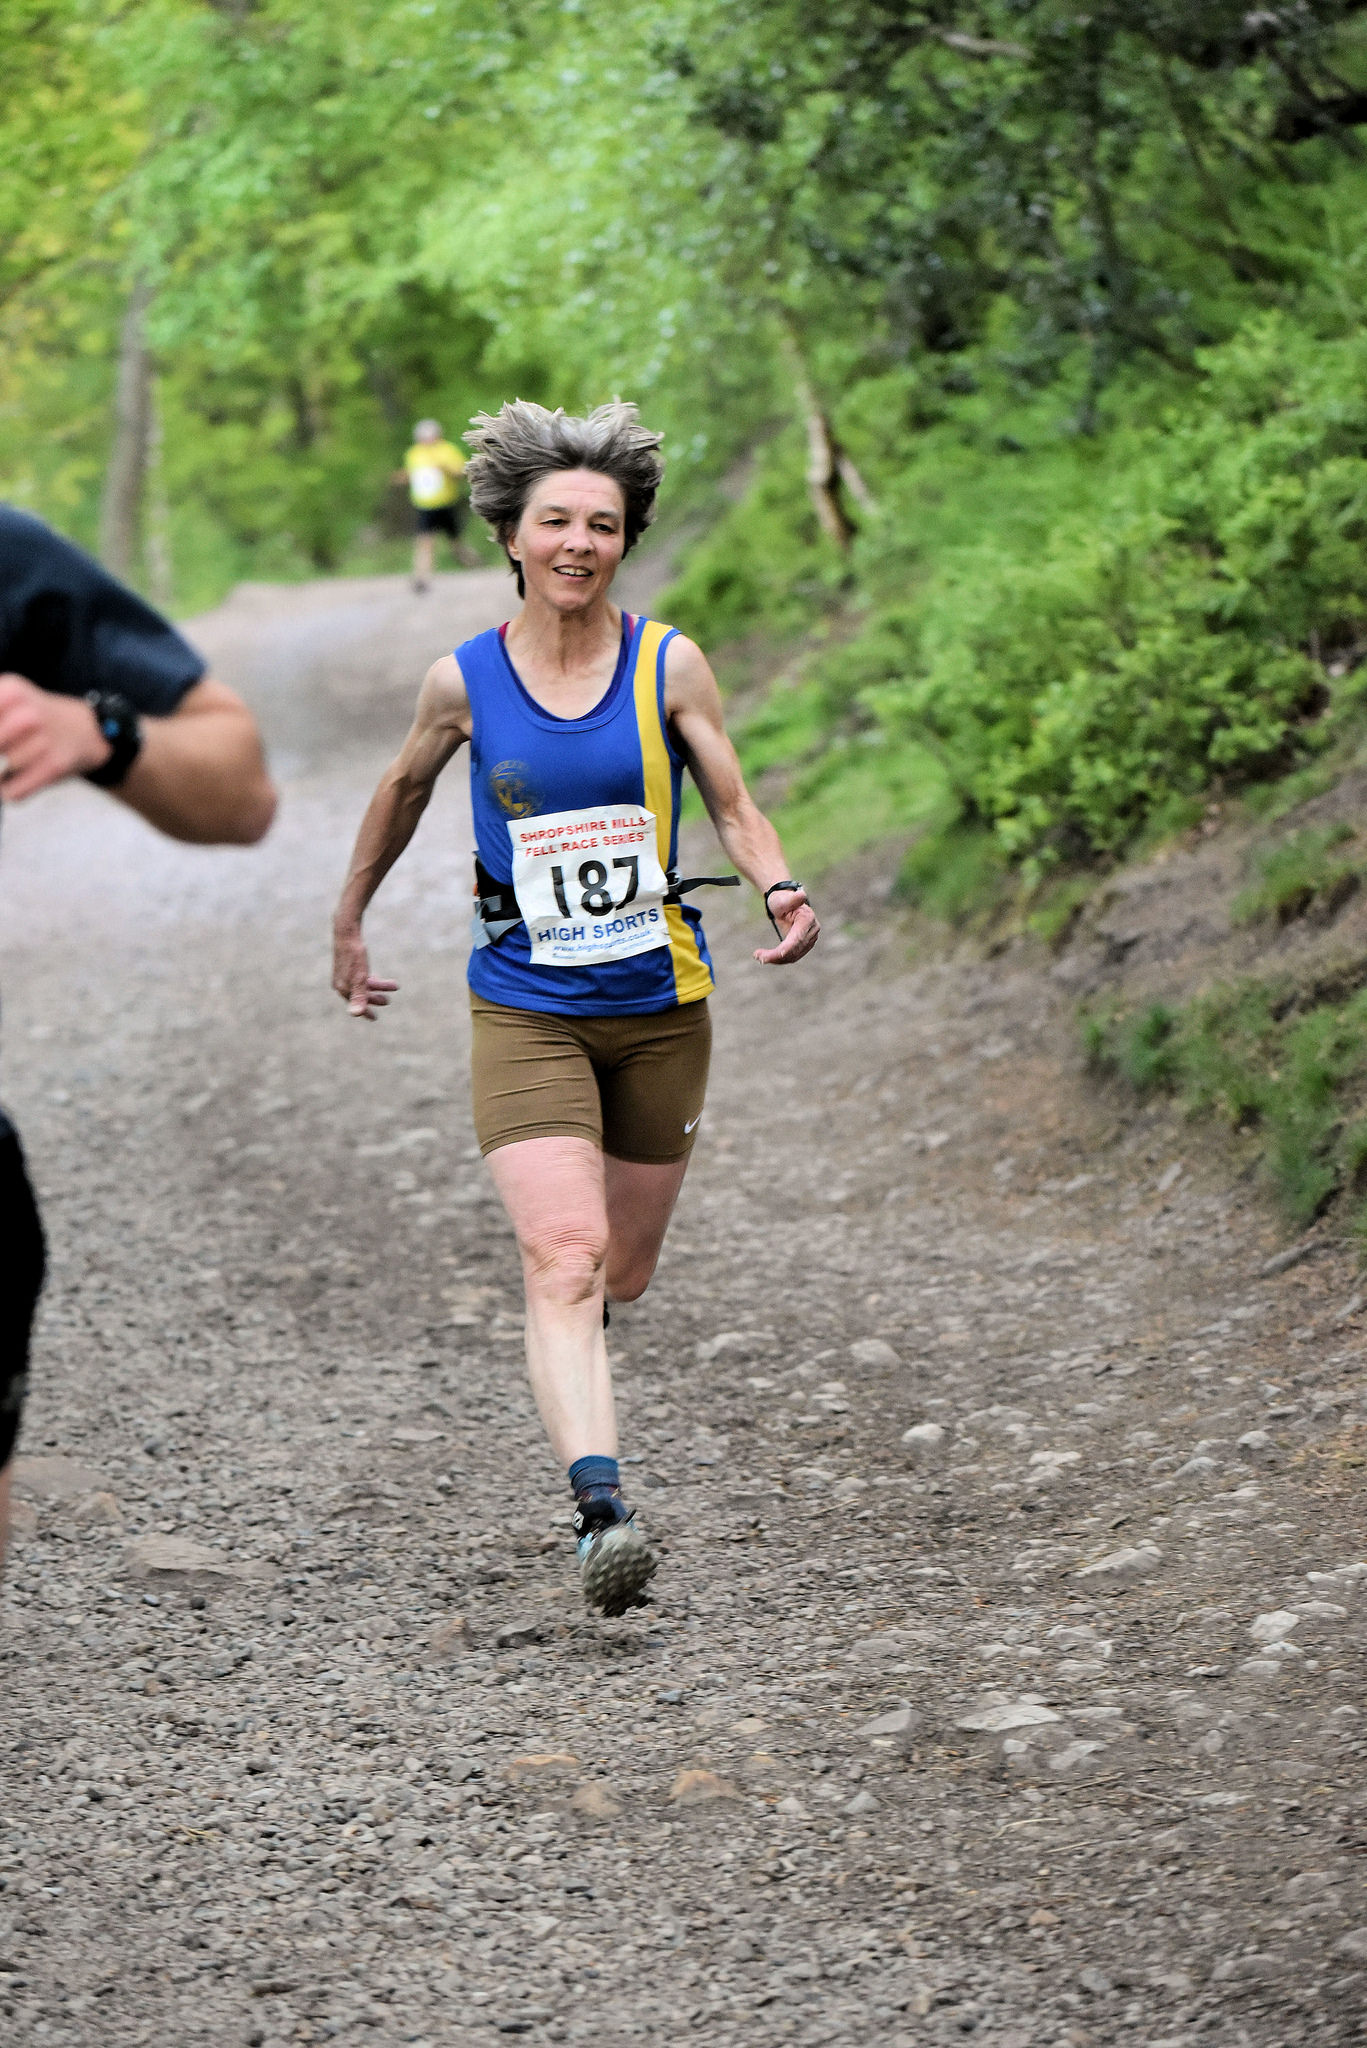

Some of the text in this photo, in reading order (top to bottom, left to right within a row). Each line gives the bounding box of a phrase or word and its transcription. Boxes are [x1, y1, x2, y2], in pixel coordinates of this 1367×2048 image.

[520, 820, 607, 843] SHROPSHIRE
[525, 831, 645, 857] FELL RACE SERIES
[550, 855, 639, 918] 187
[538, 908, 659, 942] HIGH SPORTS
